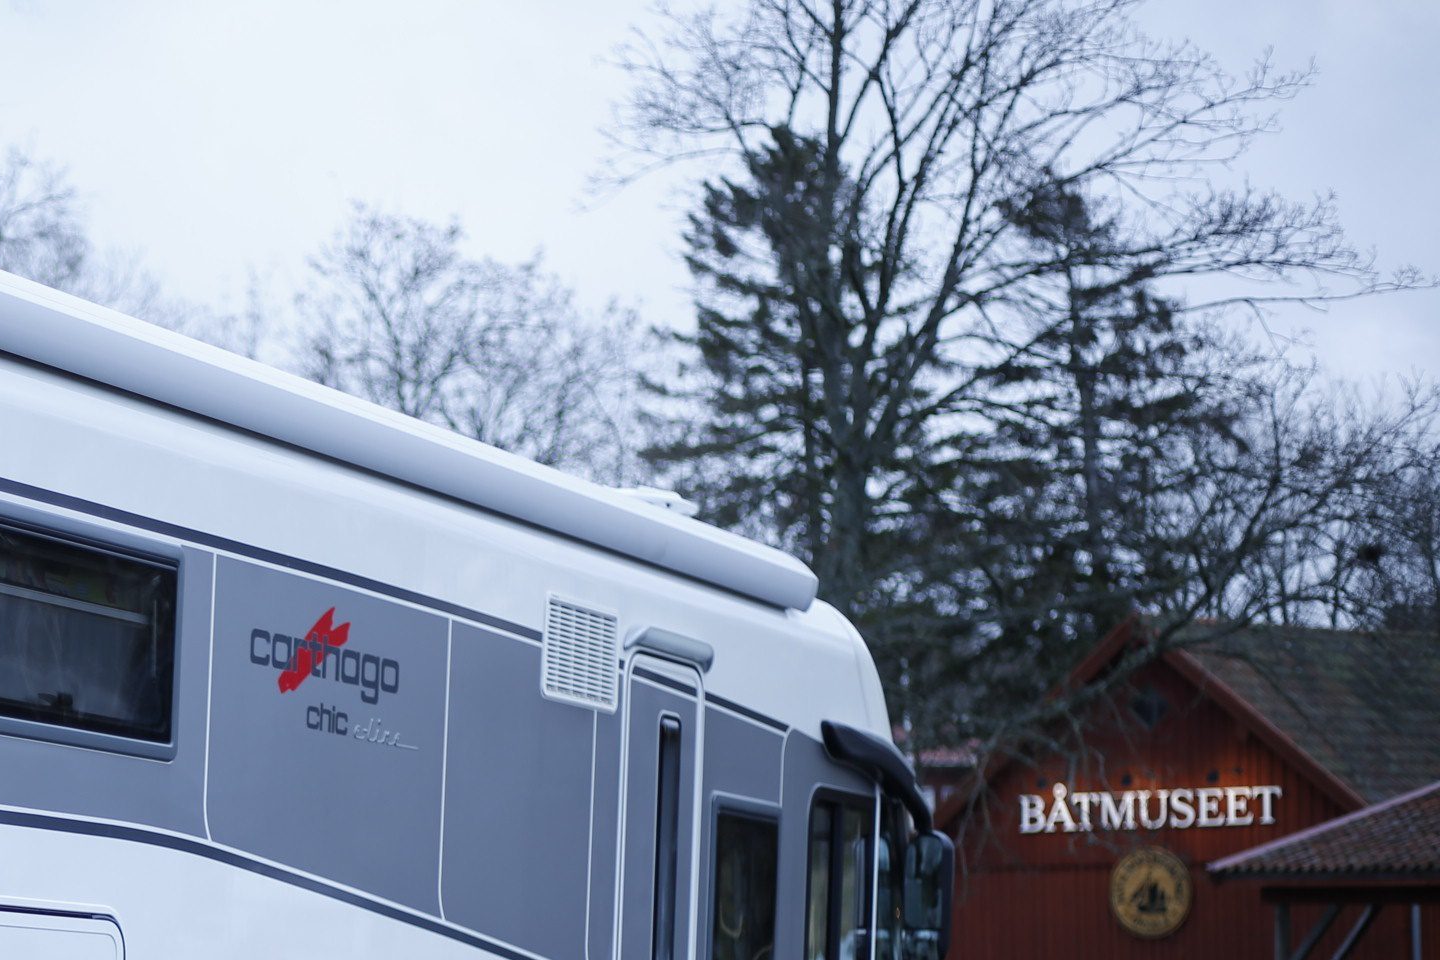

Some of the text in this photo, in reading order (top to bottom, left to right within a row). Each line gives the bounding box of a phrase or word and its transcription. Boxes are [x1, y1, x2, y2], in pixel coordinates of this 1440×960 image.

[250, 627, 400, 704] carthago
[306, 702, 348, 736] chic
[1019, 782, 1283, 834] BÅTMUSEET
